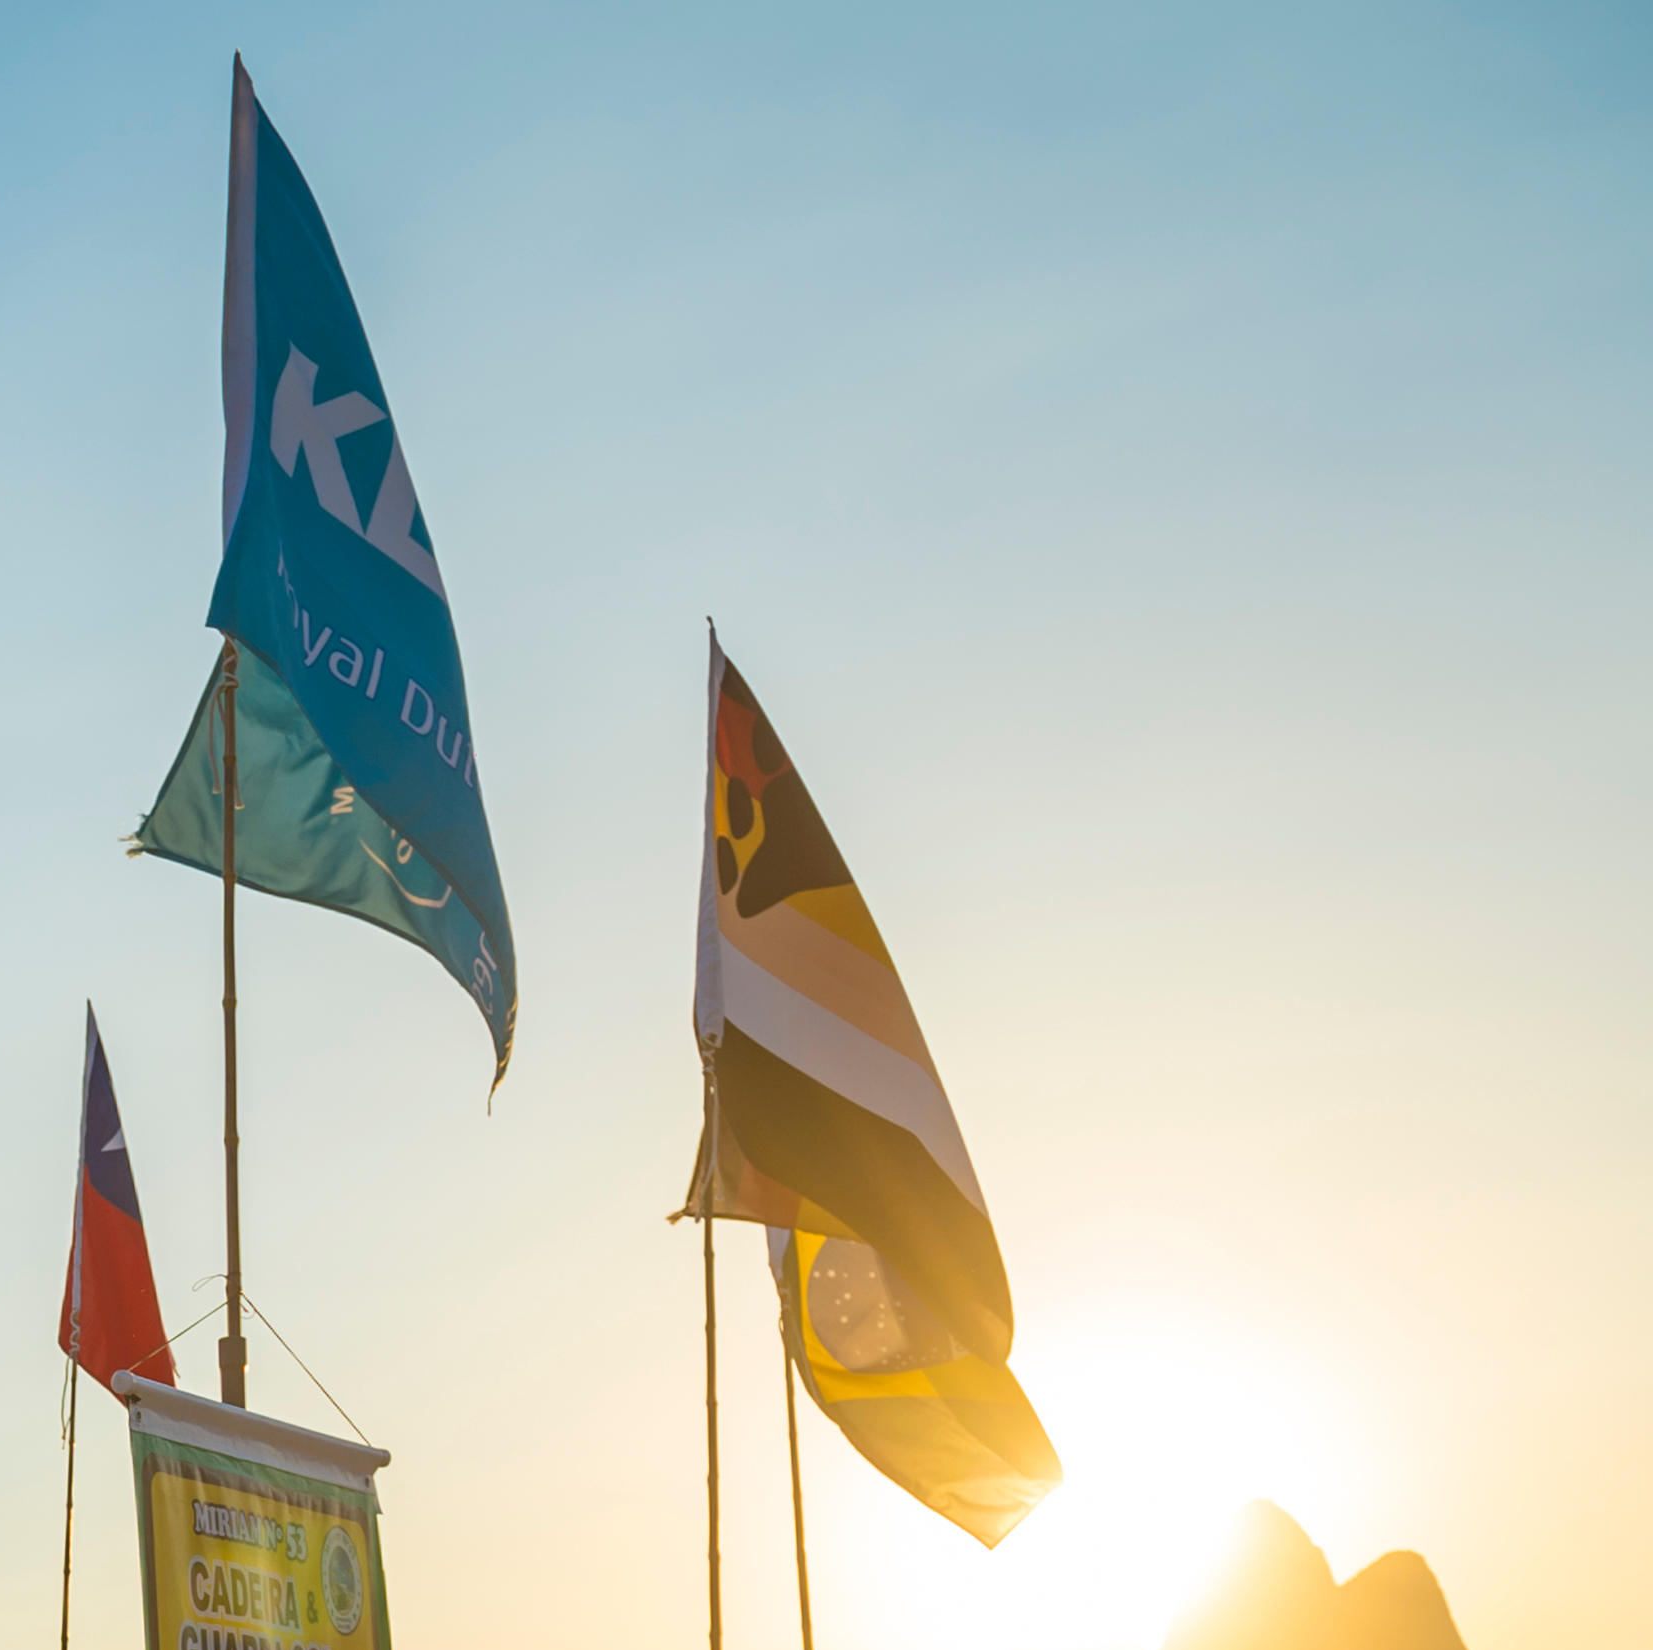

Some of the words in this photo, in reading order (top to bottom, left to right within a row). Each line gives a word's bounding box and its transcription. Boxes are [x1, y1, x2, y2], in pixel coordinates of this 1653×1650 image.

[192, 1502, 264, 1547] MIRIAM
[286, 1523, 307, 1563] 53
[191, 1558, 301, 1631] CADEIRA
[307, 1592, 318, 1624] &
